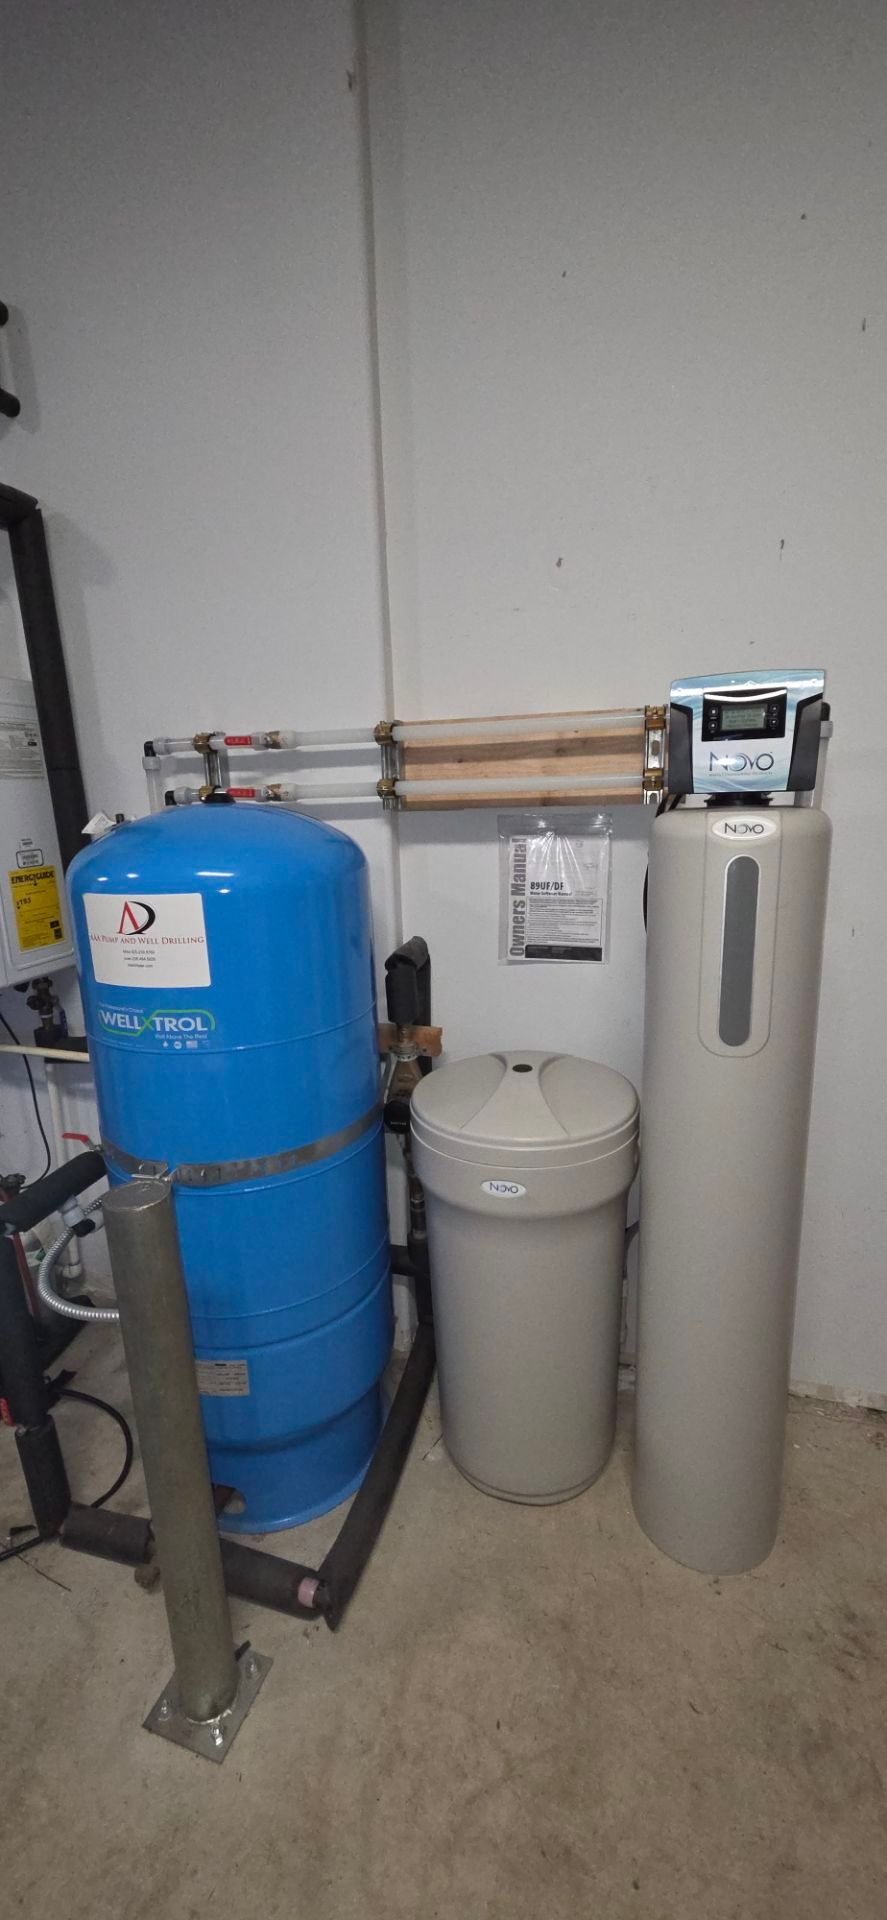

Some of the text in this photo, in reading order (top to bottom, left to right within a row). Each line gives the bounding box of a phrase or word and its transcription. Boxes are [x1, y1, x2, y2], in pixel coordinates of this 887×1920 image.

[709, 752, 774, 771] NOVO
[724, 822, 765, 834] NOVO
[530, 881, 565, 891] 89UF/DF
[509, 838, 527, 956] Owners Manual
[120, 937, 136, 945] AND
[137, 937, 159, 945] WELL
[161, 936, 206, 945] DRILLING
[489, 1182, 519, 1194] NOVO
